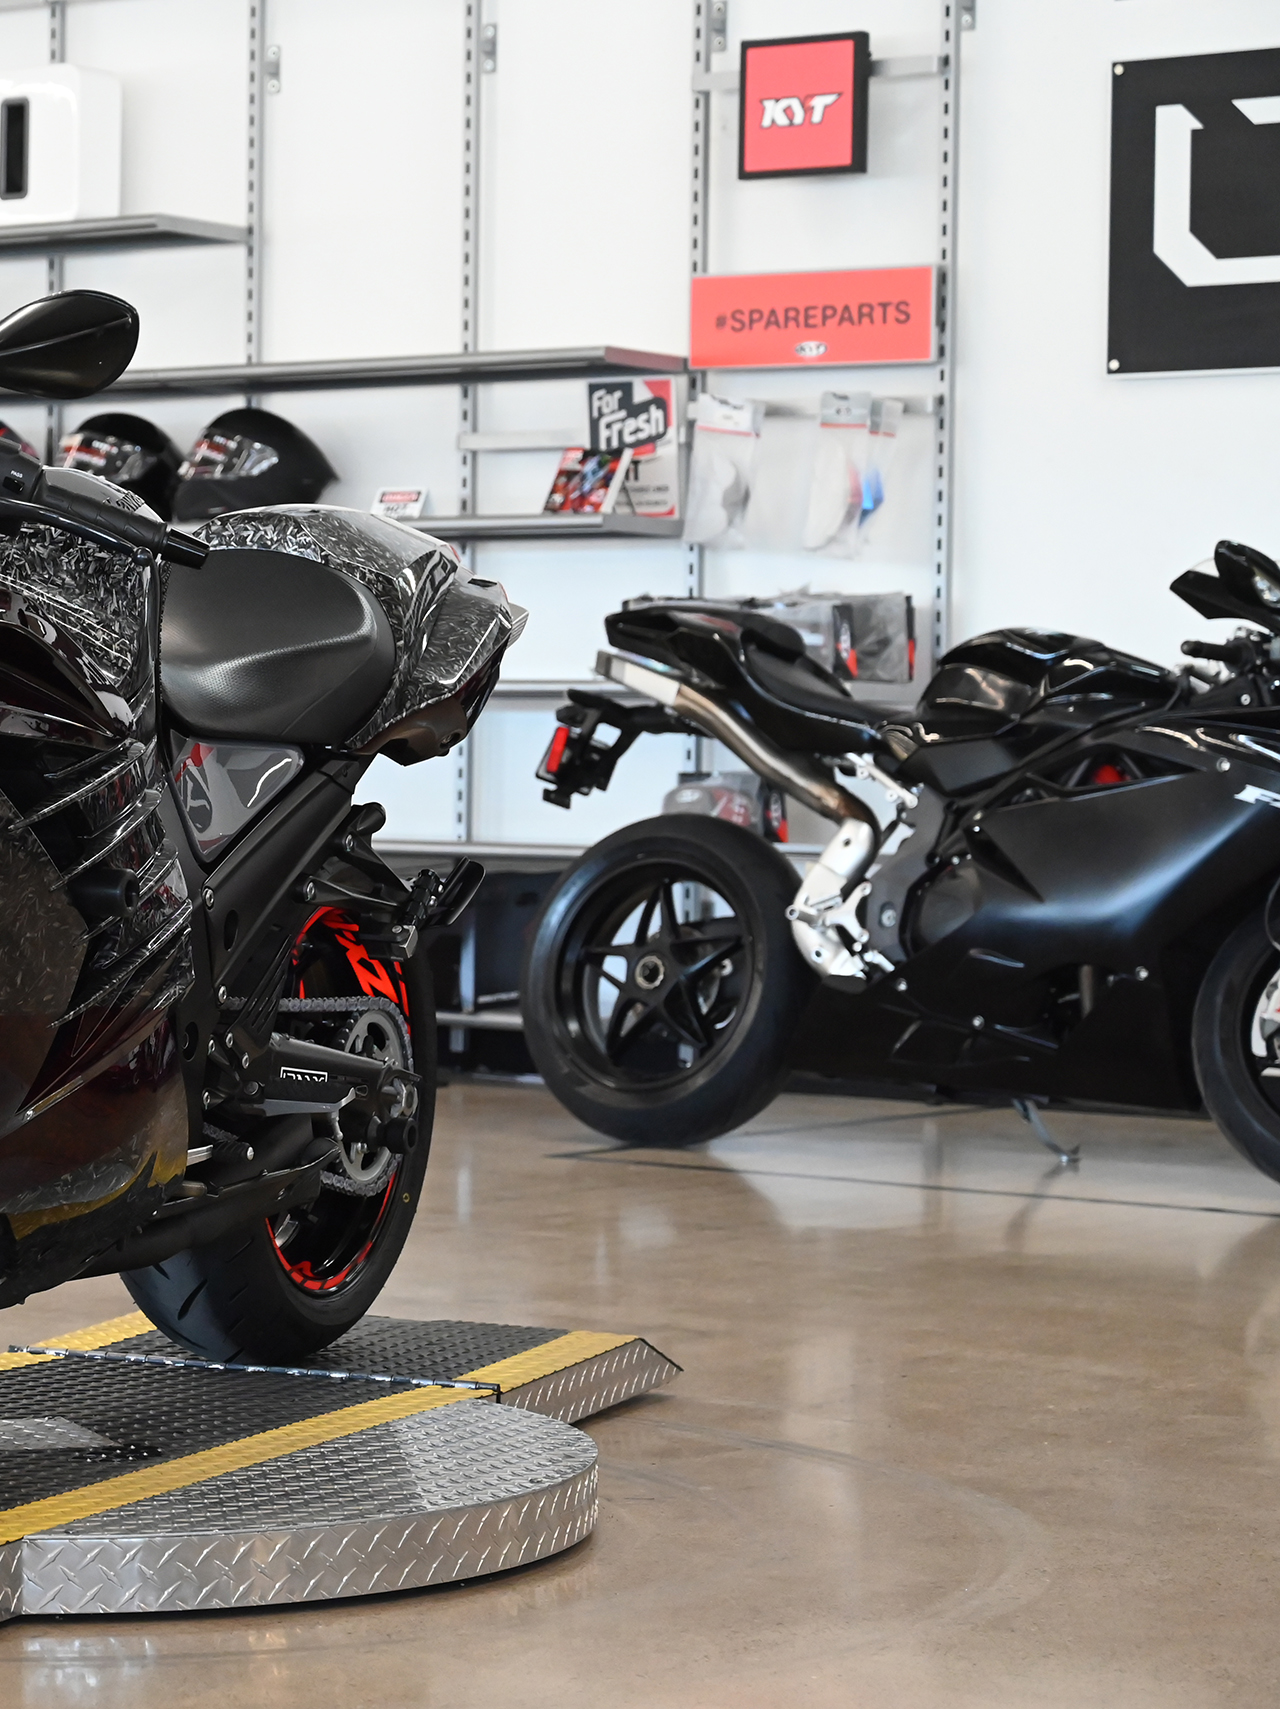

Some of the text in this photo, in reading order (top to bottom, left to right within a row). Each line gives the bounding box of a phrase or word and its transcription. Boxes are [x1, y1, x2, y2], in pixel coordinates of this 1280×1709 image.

[760, 92, 843, 128] KYT
[716, 299, 911, 333] #SPAREPARTS
[591, 387, 623, 420] For
[599, 403, 666, 451] Fresh
